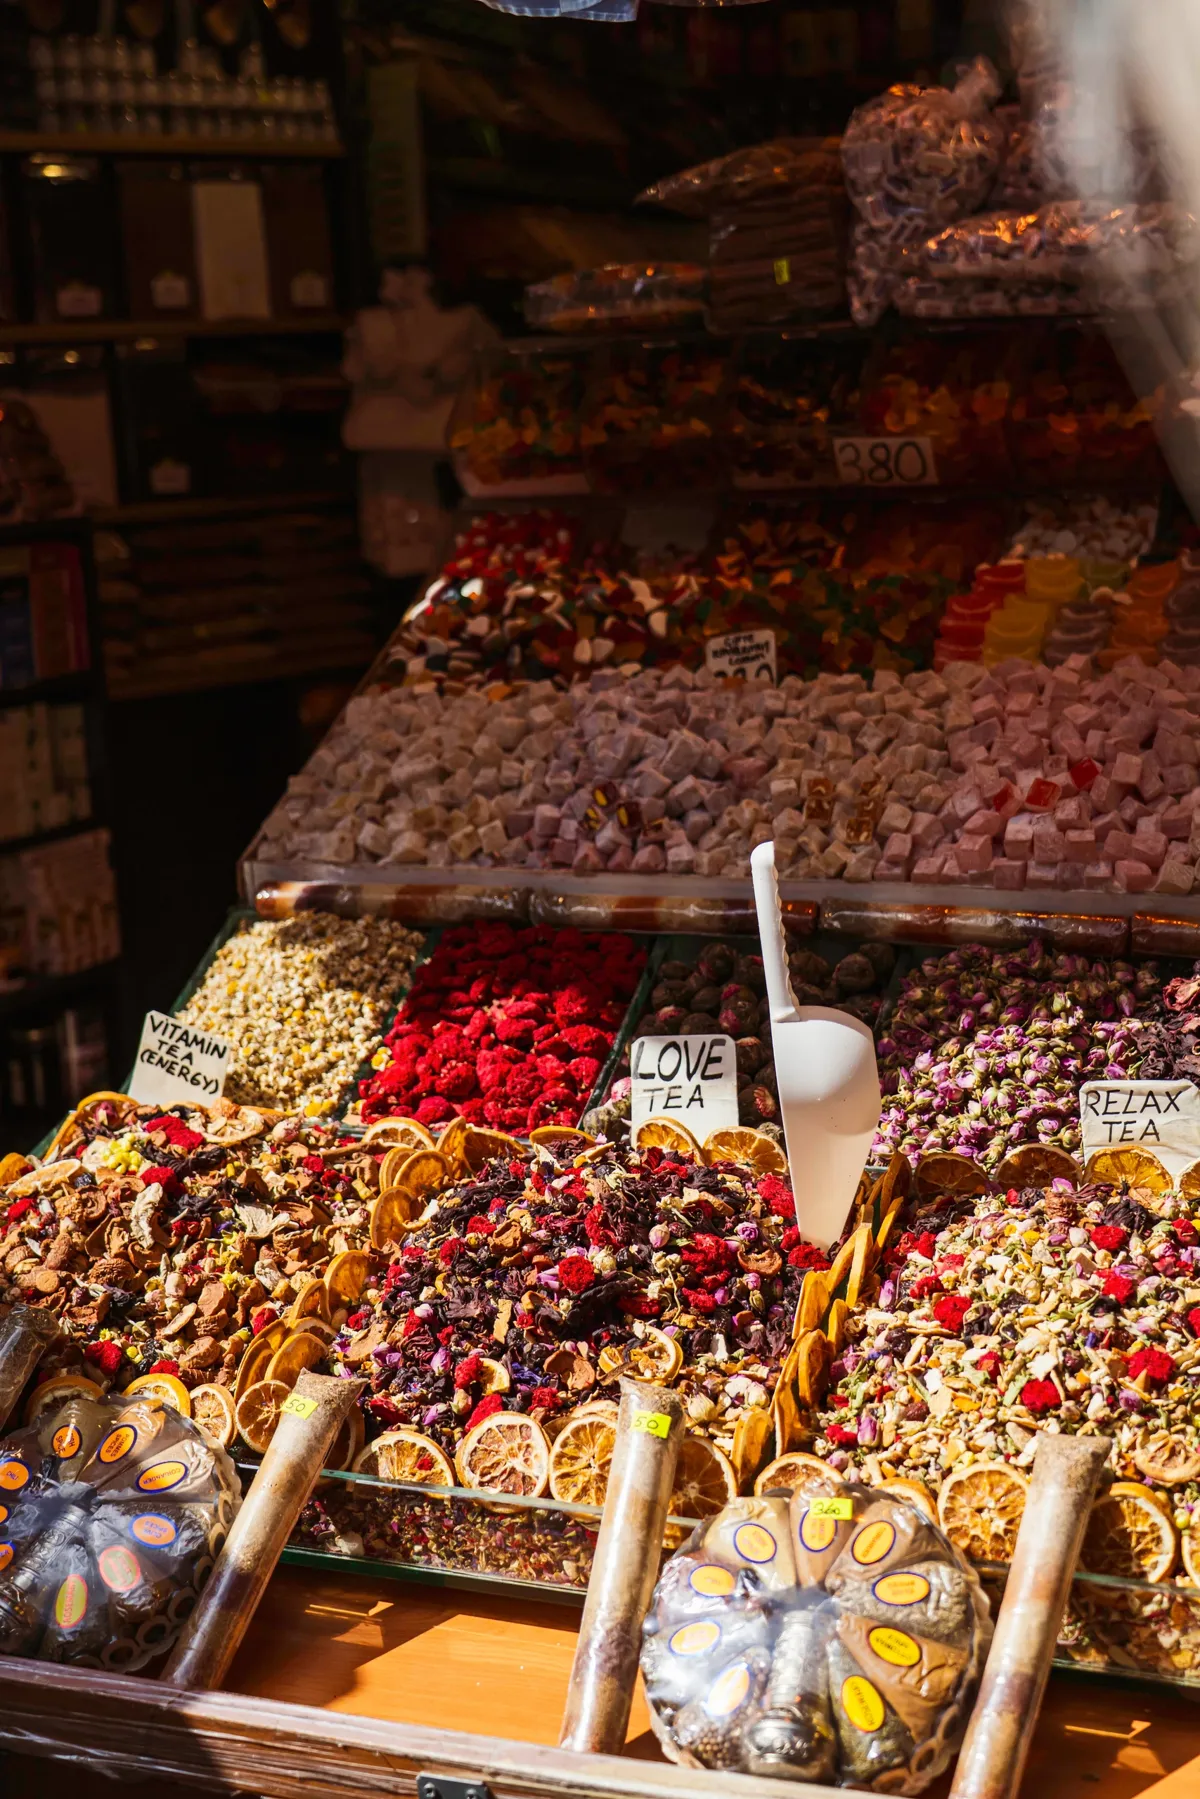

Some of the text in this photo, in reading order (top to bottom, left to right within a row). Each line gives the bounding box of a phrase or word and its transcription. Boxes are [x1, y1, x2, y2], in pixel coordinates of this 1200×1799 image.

[838, 441, 928, 483] 380
[157, 1039, 194, 1066] TEA
[632, 1038, 727, 1081] LOVE
[140, 1049, 219, 1095] (ENERGY)
[643, 1084, 704, 1112] TEA
[1083, 1089, 1184, 1116] RELAX
[1102, 1119, 1160, 1142] TEA
[286, 1399, 306, 1412] 50
[635, 1416, 659, 1429] 50
